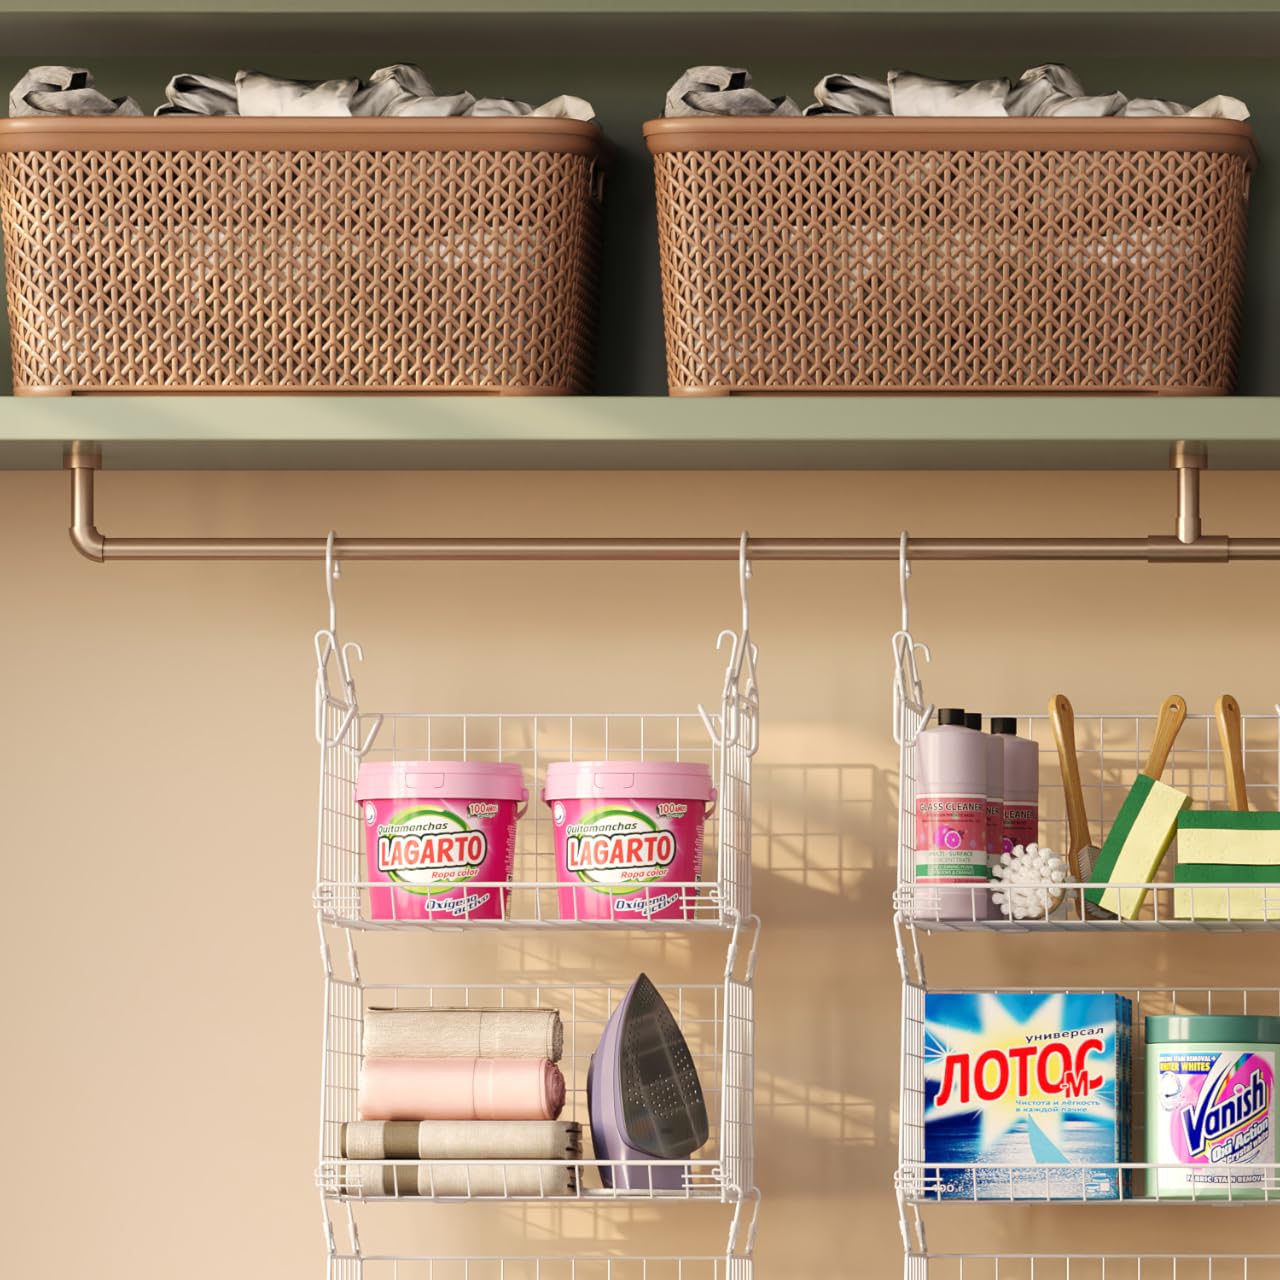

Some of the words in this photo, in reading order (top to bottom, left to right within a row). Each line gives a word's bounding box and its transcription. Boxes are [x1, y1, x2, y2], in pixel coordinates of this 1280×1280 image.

[377, 822, 448, 835] Quitamanchas
[567, 822, 637, 834] Quitamanchas
[381, 836, 482, 866] LAGARTO
[570, 836, 671, 866] LAGARTO
[1026, 1027, 1104, 1043] универсал
[1183, 1063, 1264, 1151] Vanish
[1235, 1118, 1268, 1149] Action
